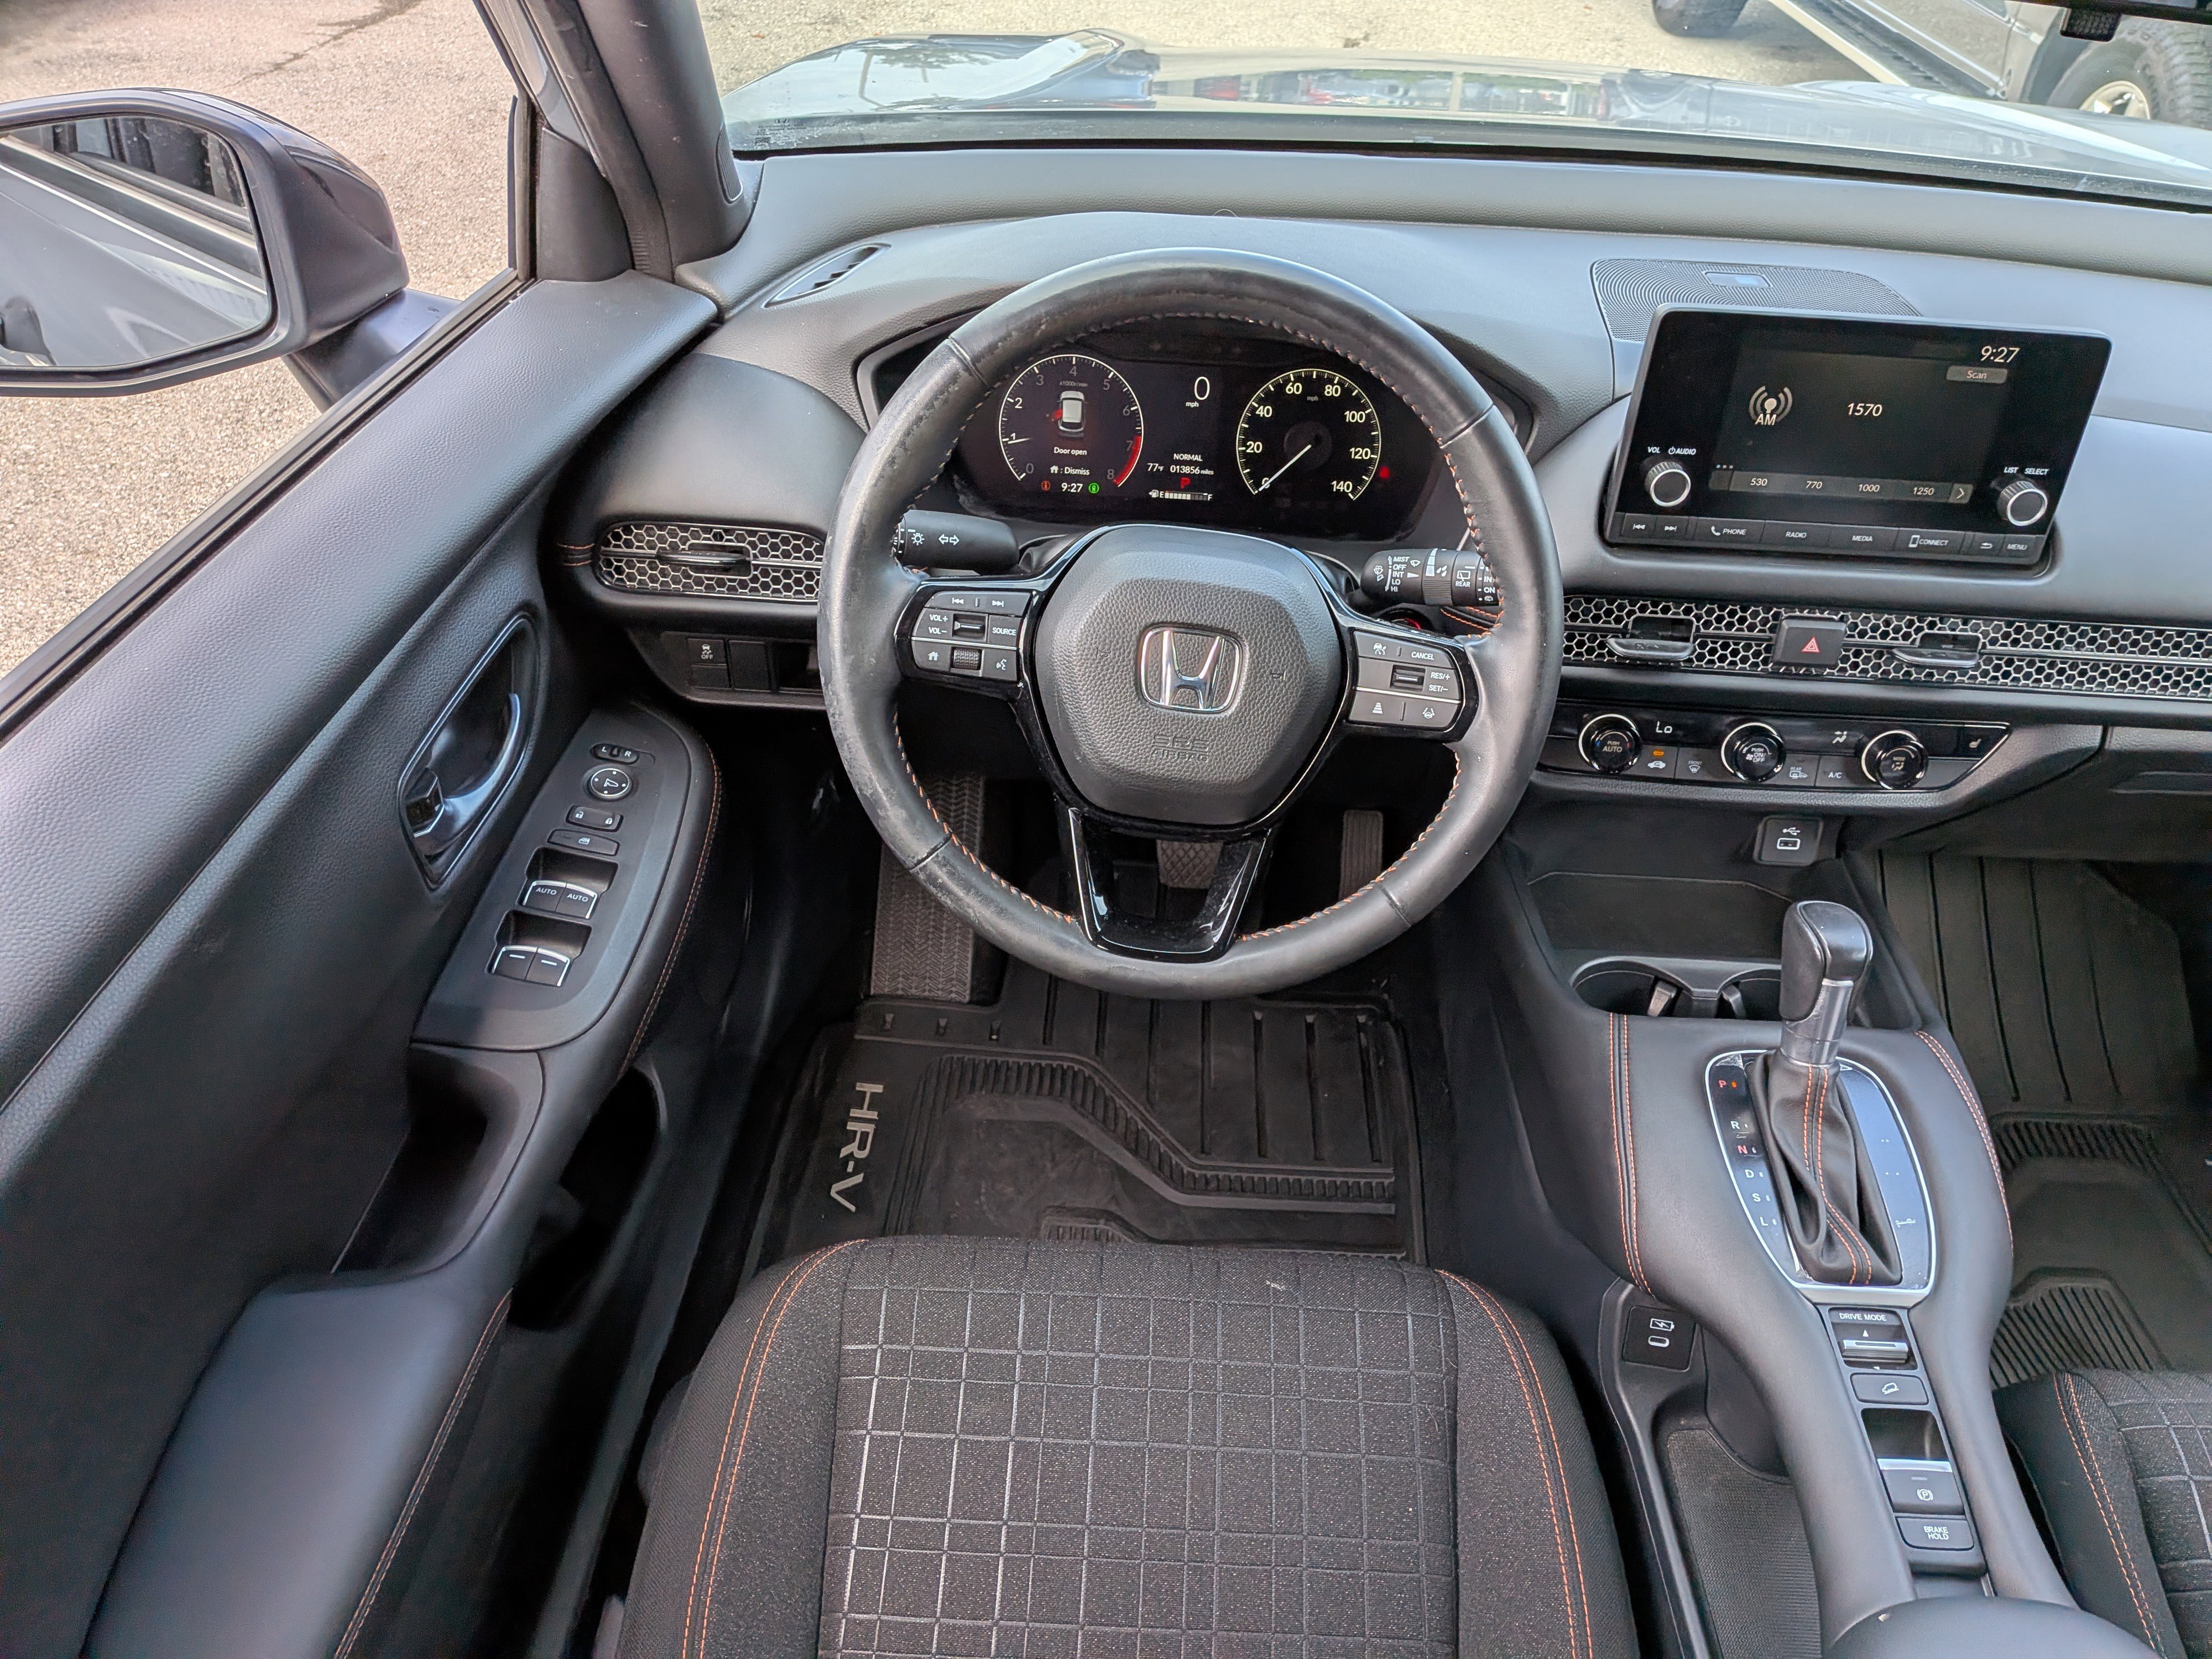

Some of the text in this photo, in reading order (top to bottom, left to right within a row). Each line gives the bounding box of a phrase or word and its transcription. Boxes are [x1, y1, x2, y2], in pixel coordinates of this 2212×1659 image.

[1980, 346, 2021, 363] 9:27
[1070, 366, 1077, 376] 4
[1966, 370, 1987, 380] Scan
[1036, 375, 1044, 385] 3
[1103, 379, 1110, 390] 5
[1194, 376, 1210, 400] 0
[1285, 383, 1302, 394] 60
[1324, 385, 1341, 397] 80
[1015, 398, 1022, 408] 2
[1123, 405, 1130, 415] 6
[1256, 406, 1272, 418] 40
[1847, 402, 1883, 417] 1570
[1344, 411, 1366, 422] 100
[1754, 413, 1777, 426] AM
[1246, 441, 1262, 453] 20
[1173, 453, 1203, 461] NORMAL
[1349, 448, 1371, 459] 120
[1026, 463, 1034, 473] 0
[1065, 467, 1089, 476] Dismiss
[1170, 465, 1200, 474] 013856
[1108, 469, 1114, 479] 8
[1061, 483, 1083, 493] 9:27
[1180, 477, 1191, 489] P
[1331, 481, 1353, 492] 140
[1806, 481, 1823, 489] 770
[1858, 484, 1880, 492] 1000
[1913, 487, 1934, 495] 1250
[992, 627, 1016, 636] SOURCE
[1411, 651, 1434, 660] CANCEL
[1431, 671, 1451, 680] RES/+
[1656, 721, 1673, 733] Lo
[1153, 734, 1210, 752] SRS
[535, 887, 557, 895] AUTO
[567, 893, 588, 902] AUTO
[1731, 1121, 1740, 1129] R
[830, 1082, 884, 1213] HR-V
[1738, 1145, 1748, 1154] N
[1745, 1169, 1754, 1178] D
[1752, 1193, 1761, 1202] S
[1760, 1217, 1768, 1226] L
